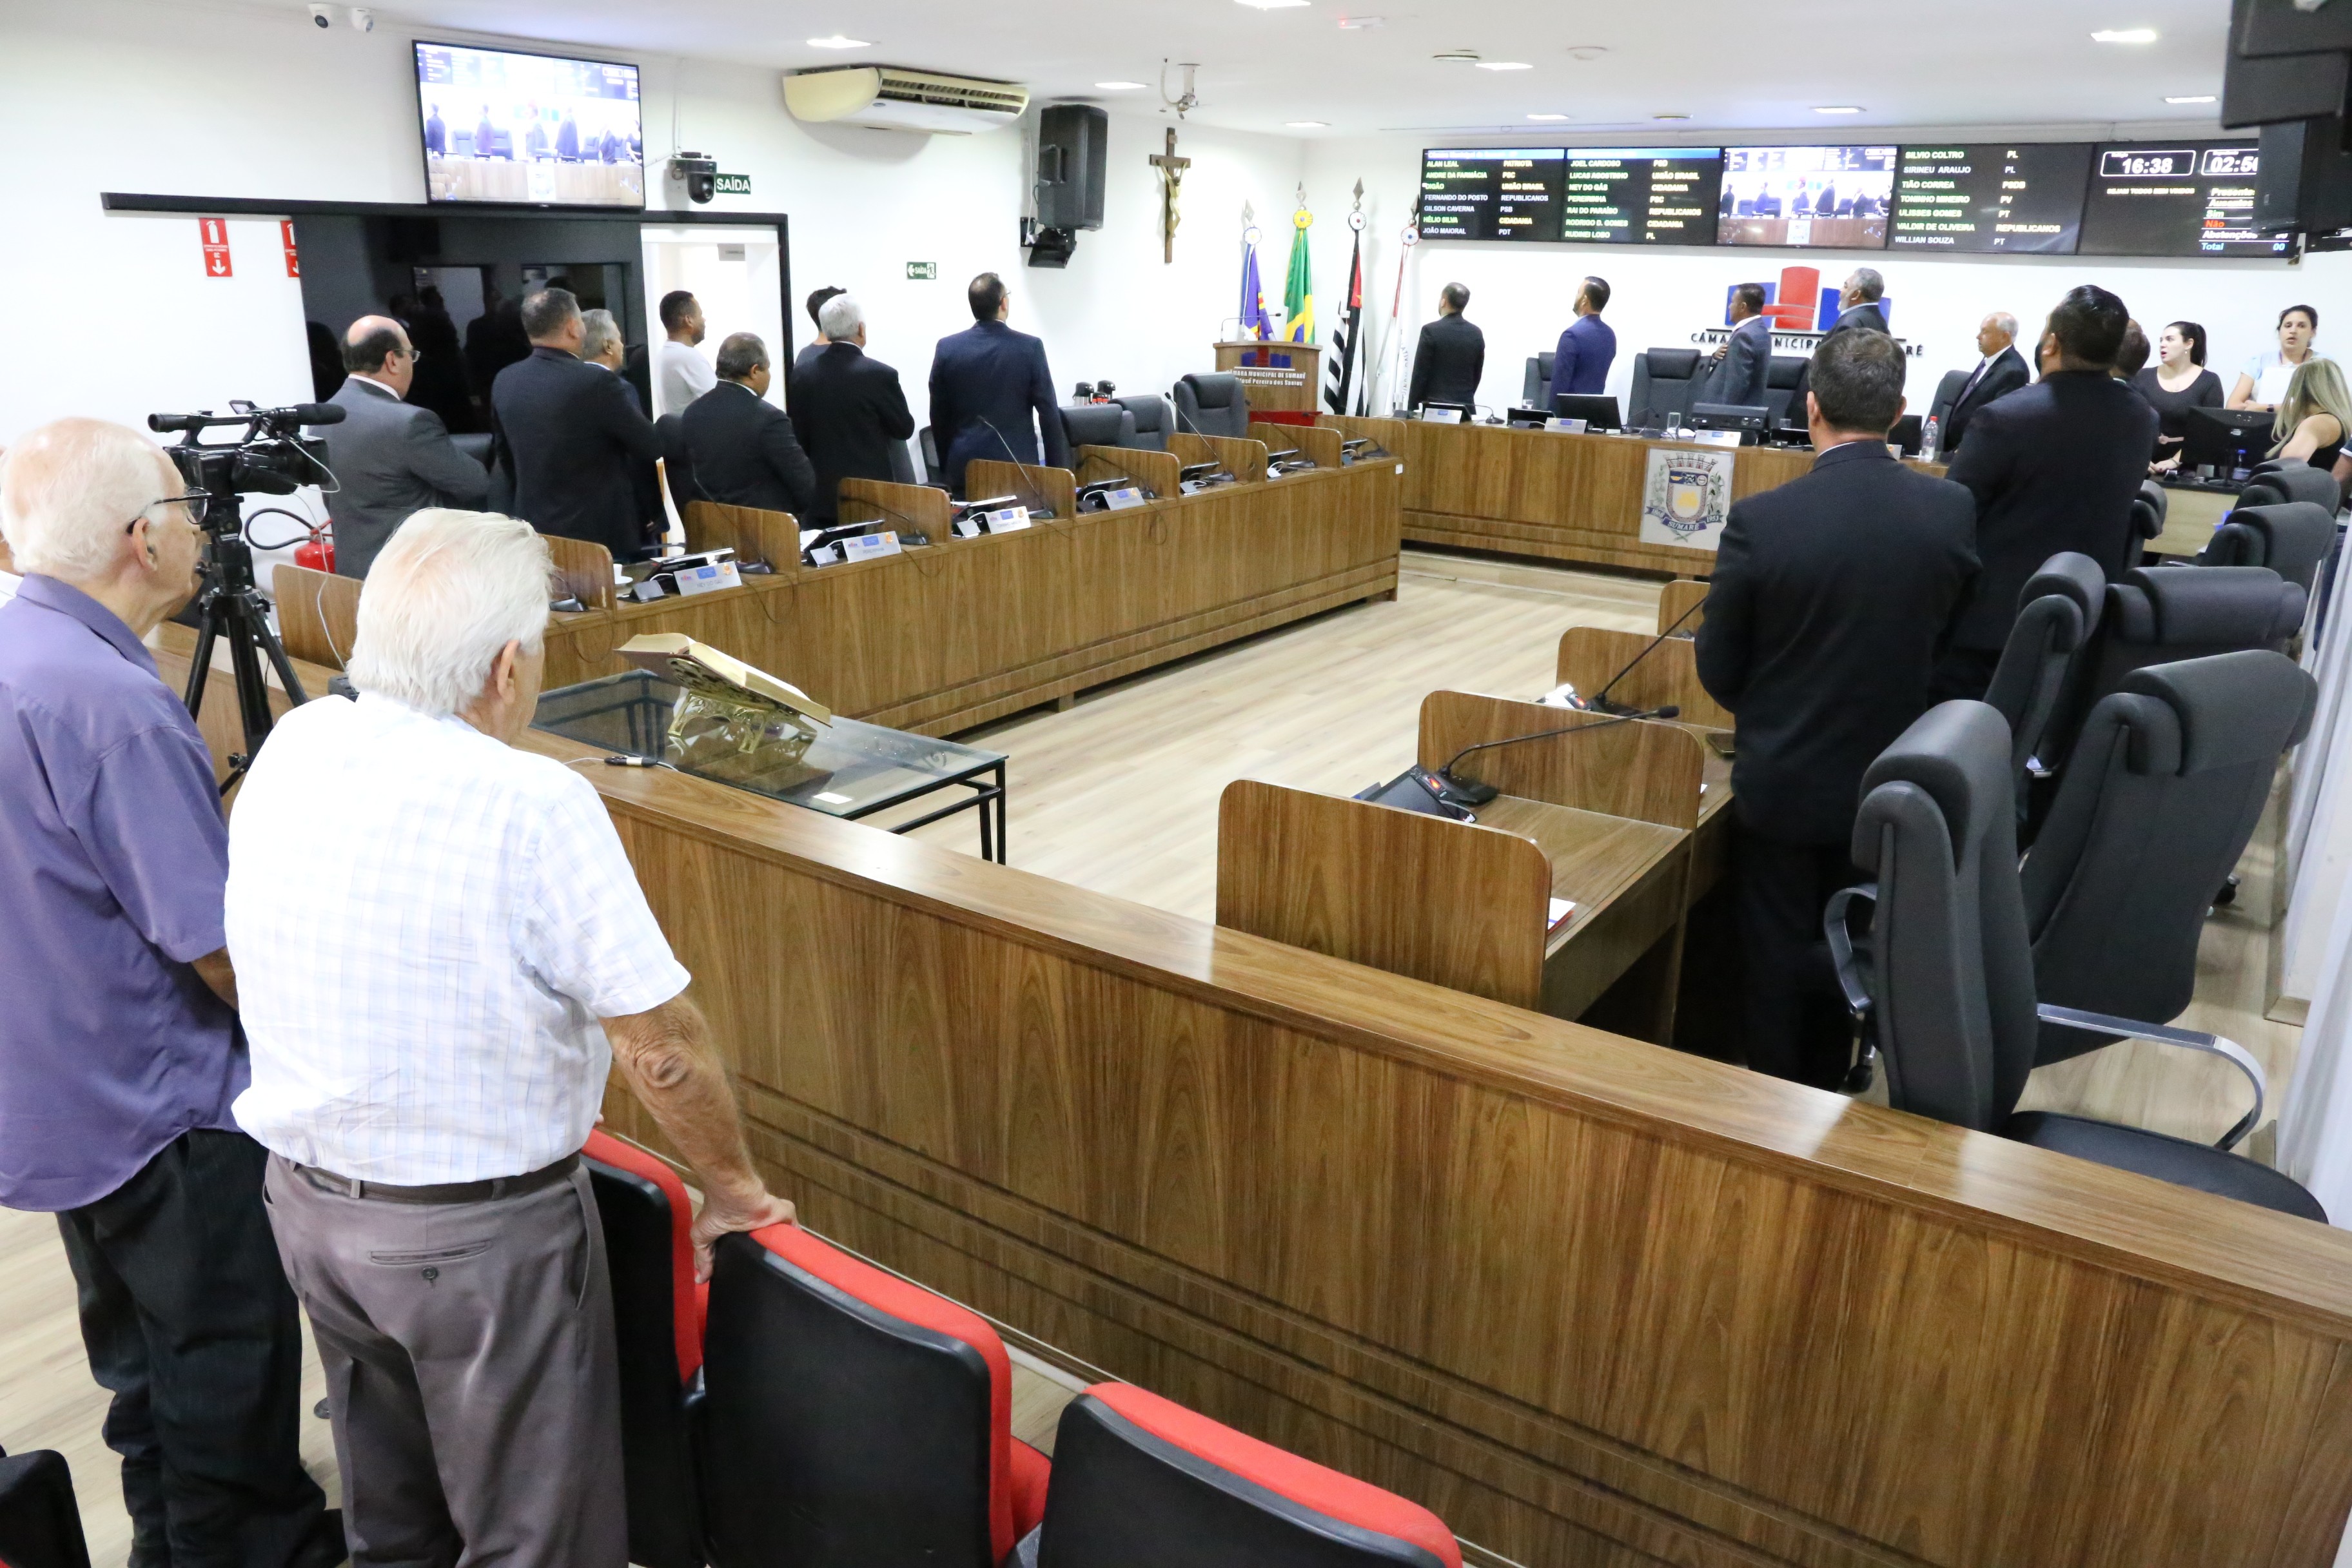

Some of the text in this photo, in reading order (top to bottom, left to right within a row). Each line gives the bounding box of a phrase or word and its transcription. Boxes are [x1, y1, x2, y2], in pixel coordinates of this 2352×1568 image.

[2122, 158, 2173, 174] 16:38
[717, 176, 750, 191] SAÍDA
[1594, 182, 1608, 191] GÁS
[1902, 180, 1920, 188] TIÃO
[1691, 333, 1727, 343] CÂMA
